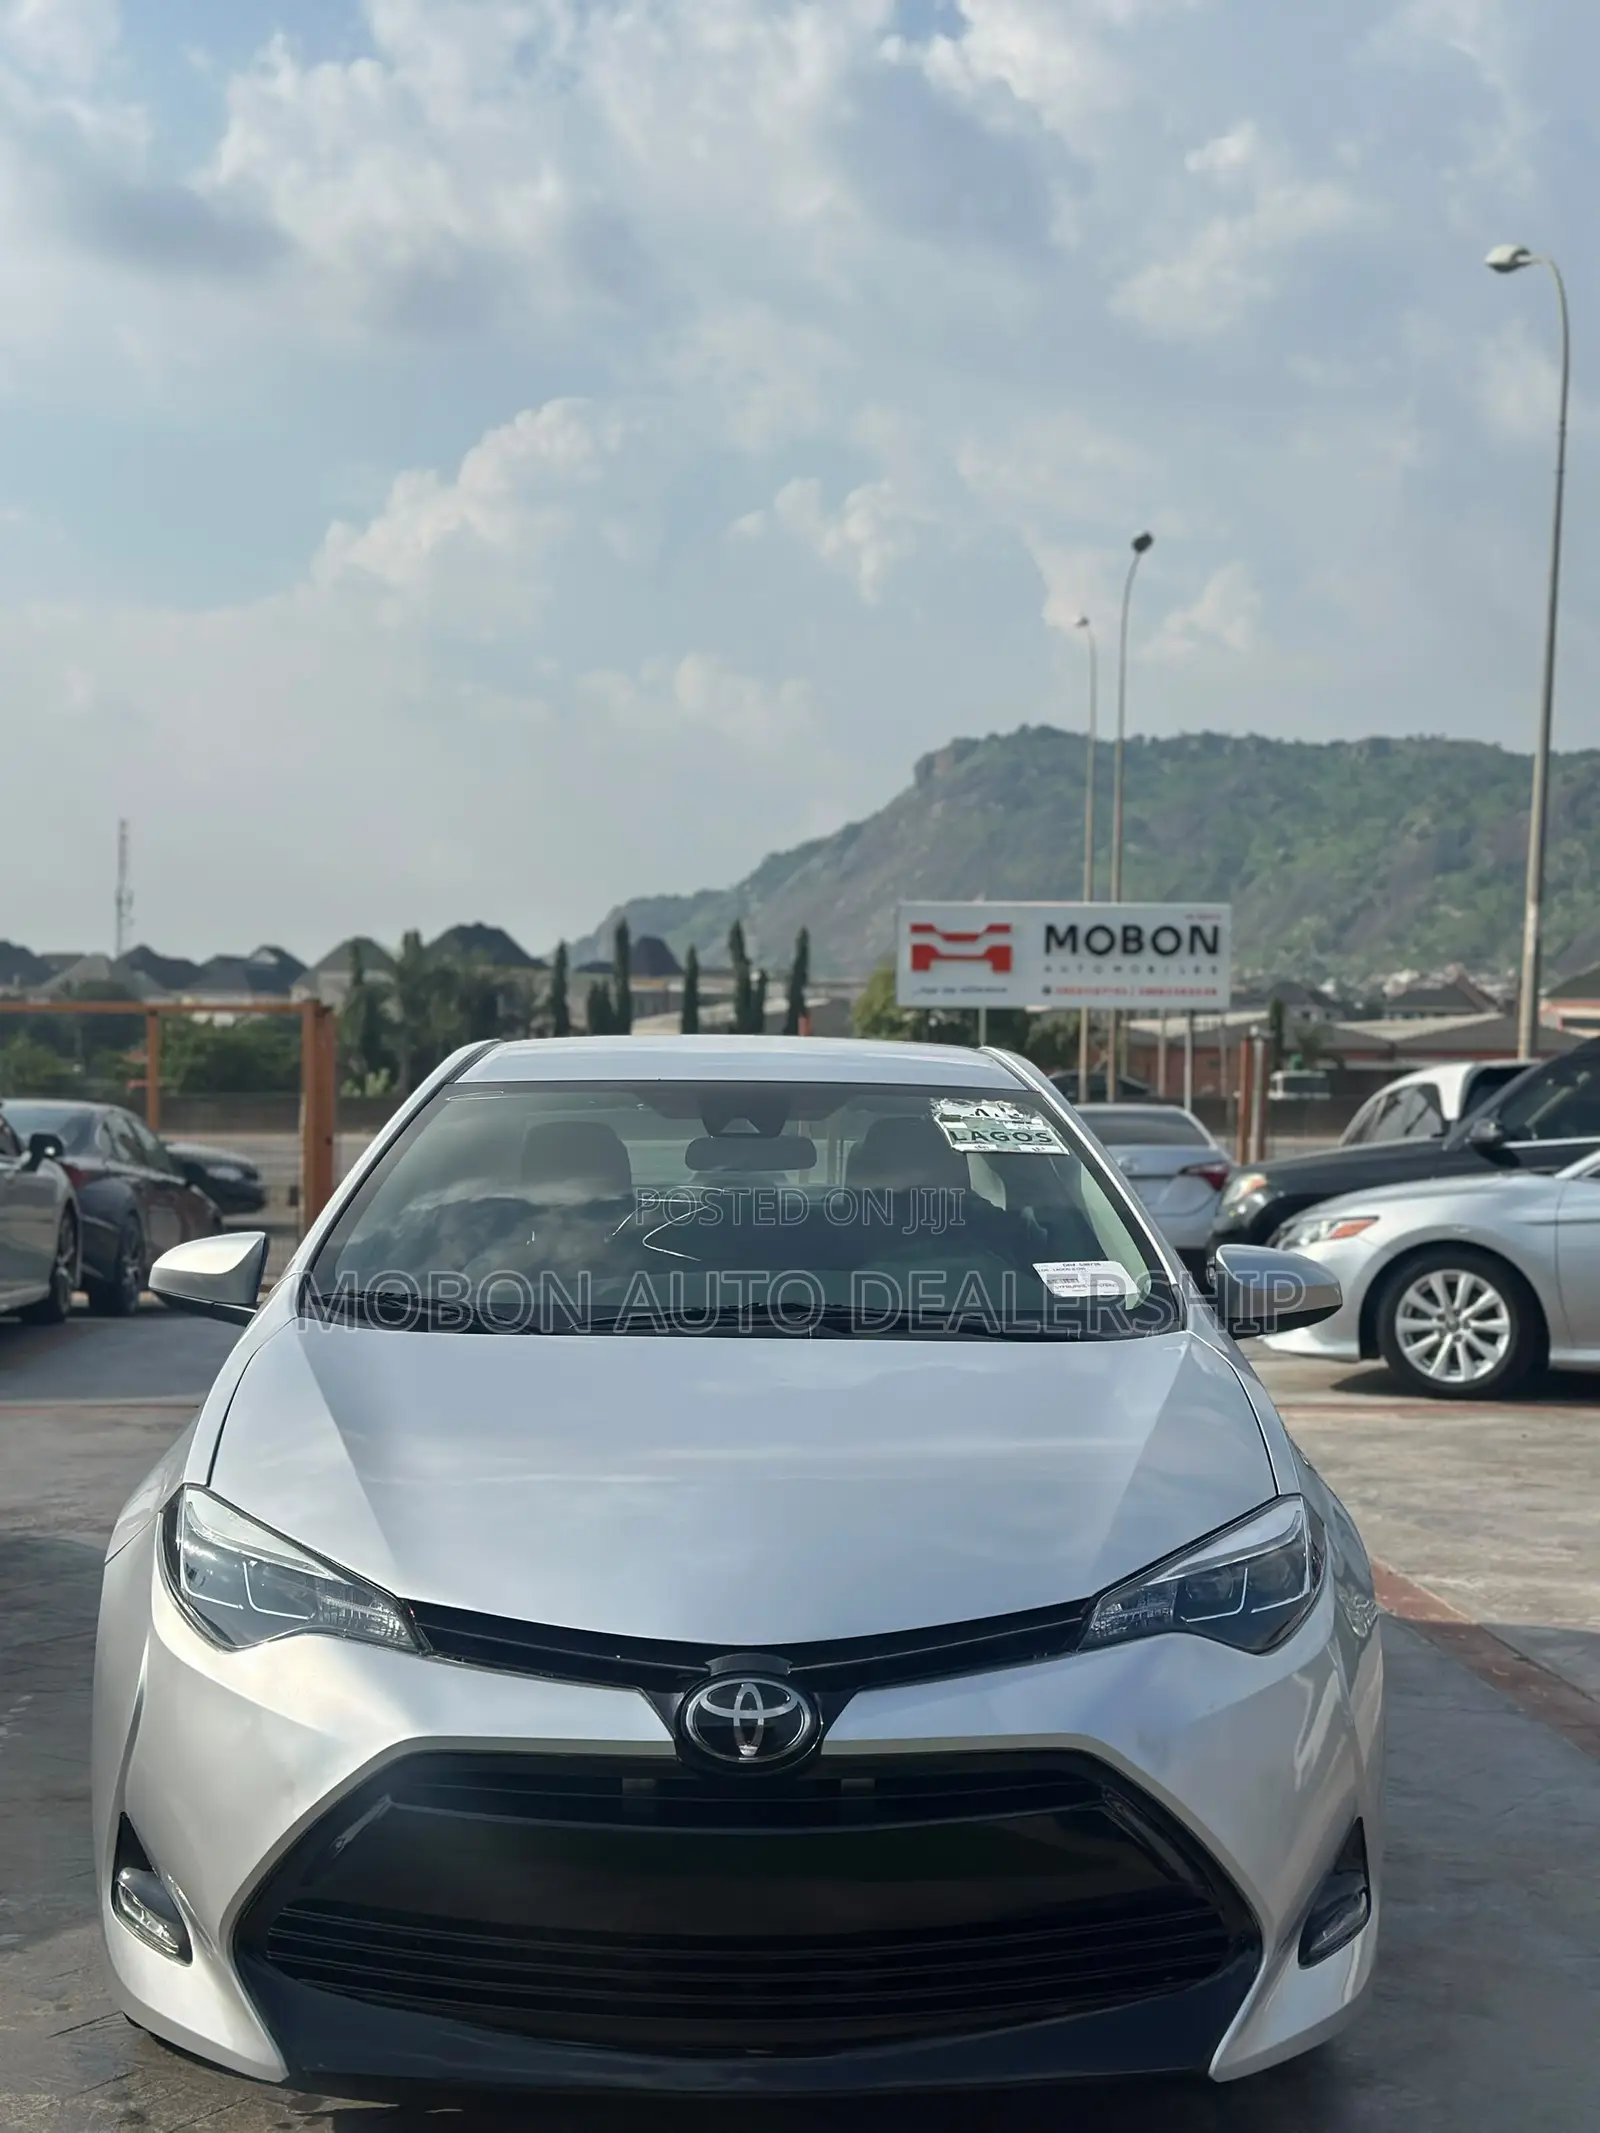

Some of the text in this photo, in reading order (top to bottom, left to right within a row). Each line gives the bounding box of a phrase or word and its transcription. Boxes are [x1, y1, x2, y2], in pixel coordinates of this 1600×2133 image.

[1044, 924, 1219, 956] MOBON
[1043, 964, 1218, 975] AUTOMOBILES
[949, 1130, 1053, 1144] LAGOS
